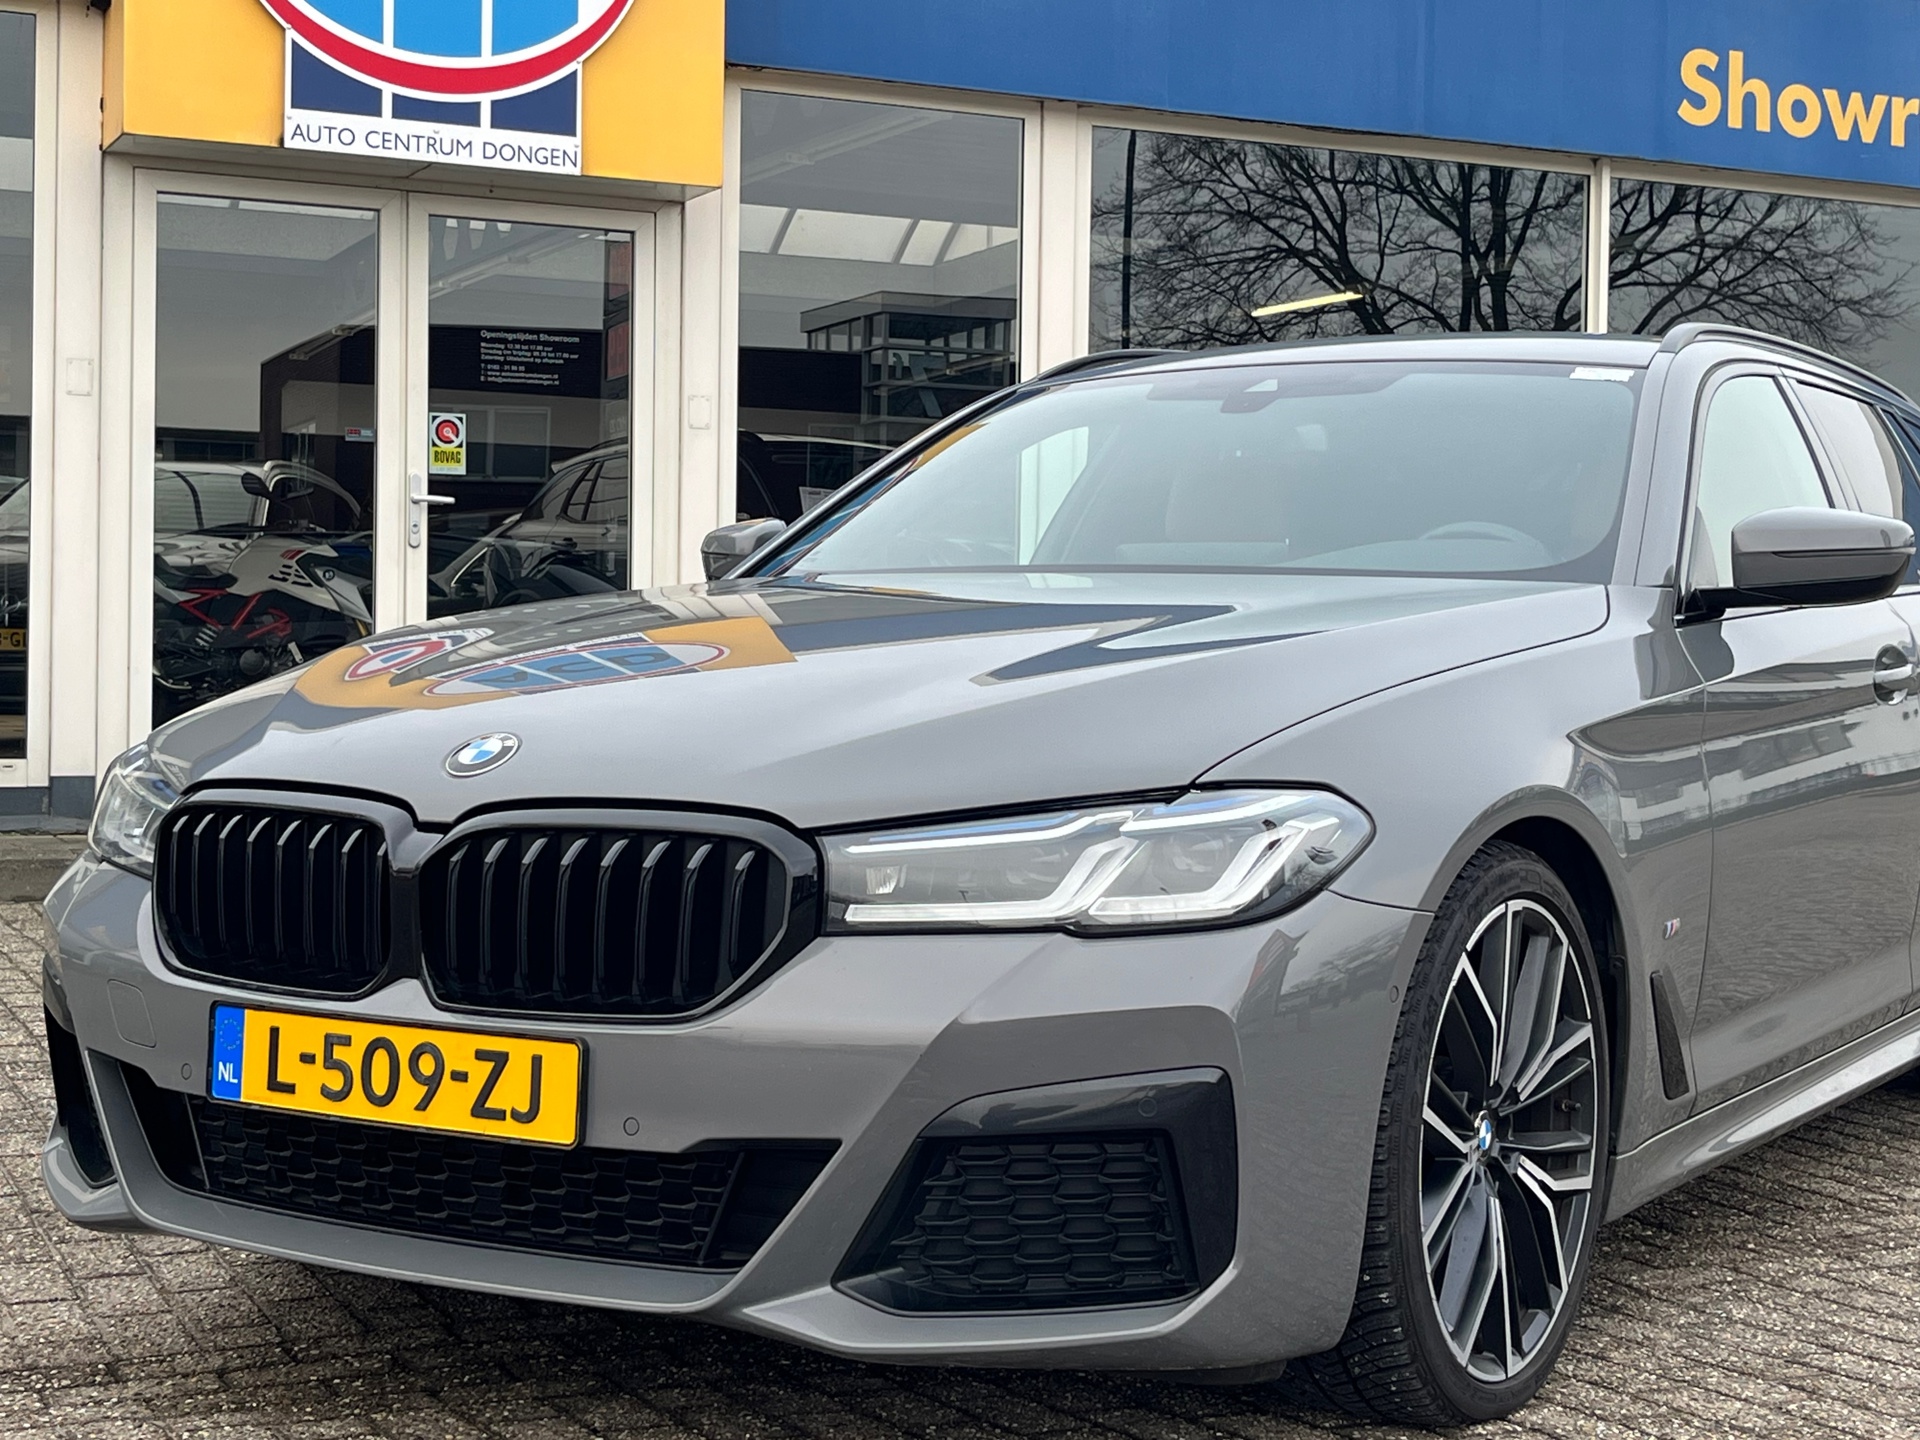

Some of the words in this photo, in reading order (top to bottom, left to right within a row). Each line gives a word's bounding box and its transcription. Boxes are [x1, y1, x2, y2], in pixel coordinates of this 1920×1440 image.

[1677, 47, 1920, 148] Showr
[290, 123, 355, 146] AUTO
[364, 130, 473, 158] CENTRUM
[482, 141, 579, 168] DONGEN
[480, 329, 537, 341] Openingstijden
[539, 333, 580, 343] Showroom
[434, 450, 462, 464] BOVAG
[217, 1060, 239, 1085] NL
[266, 1025, 544, 1125] L-509-ZJ
